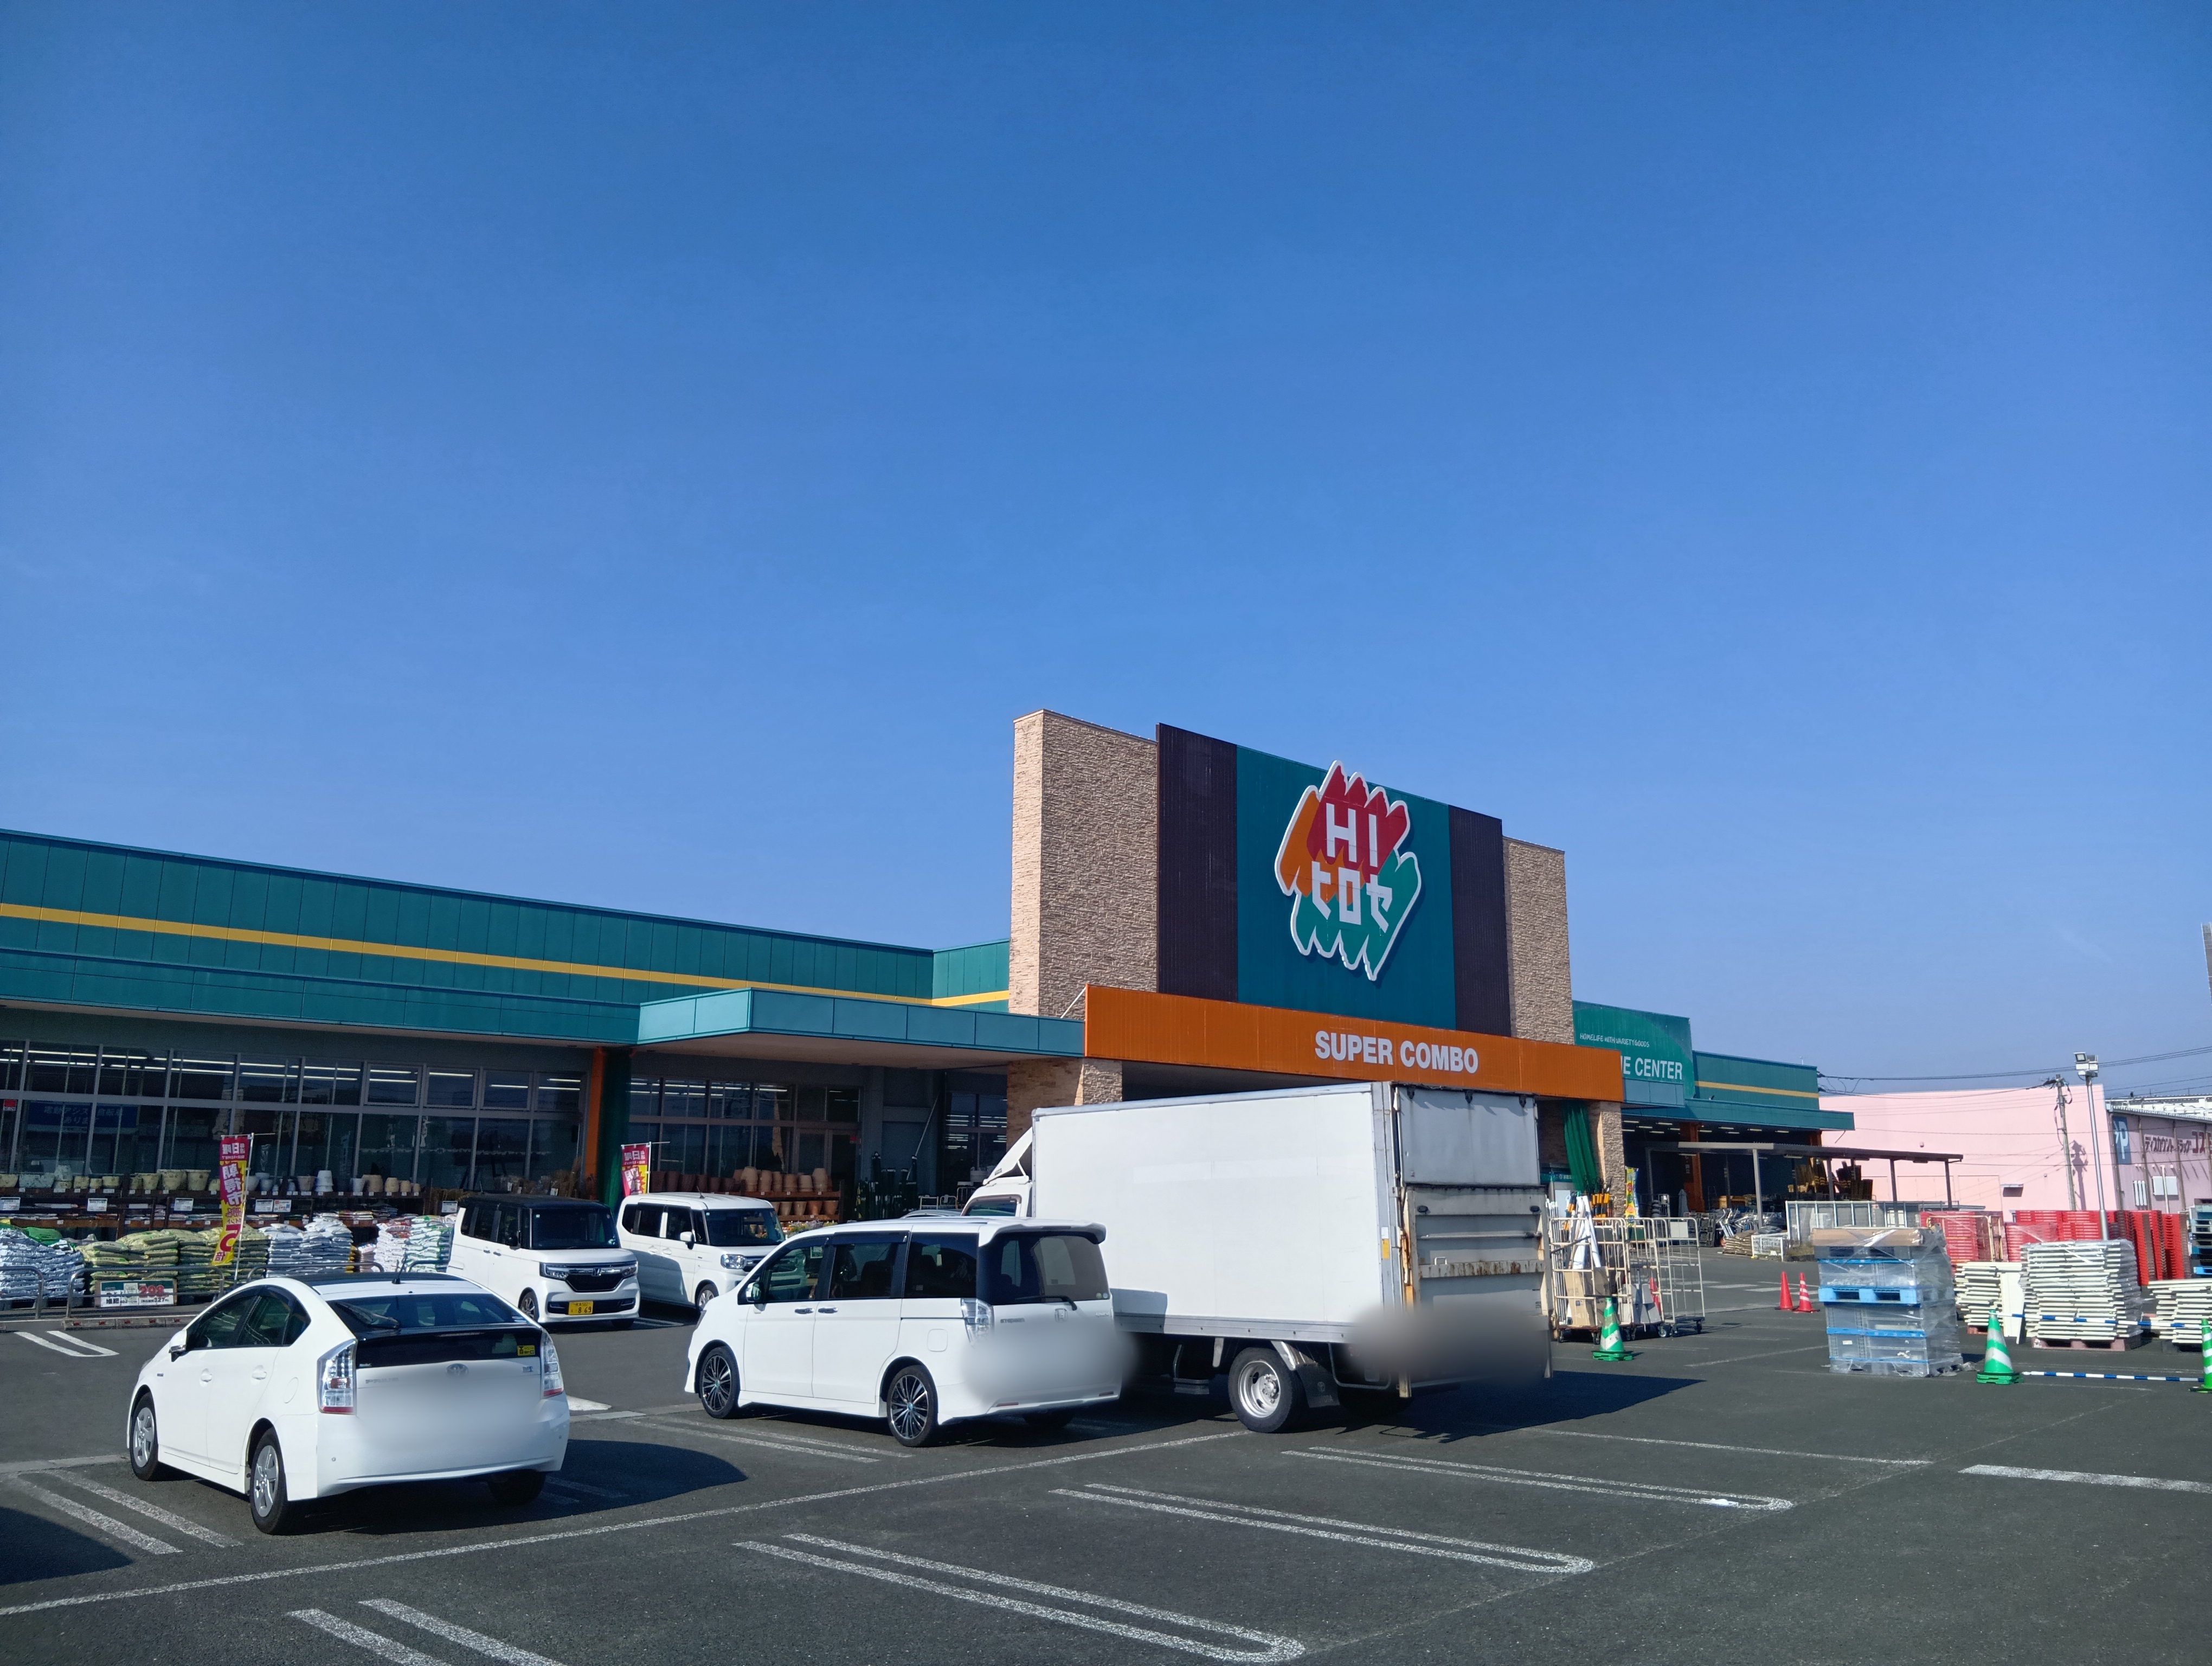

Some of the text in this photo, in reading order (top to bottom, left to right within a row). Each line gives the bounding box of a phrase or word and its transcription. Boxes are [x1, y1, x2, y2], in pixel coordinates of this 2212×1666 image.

[1315, 1030, 1478, 1074] SUPER COMBO
[1621, 1055, 1682, 1080] E CENTER
[2177, 1139, 2191, 1154] ラッグ
